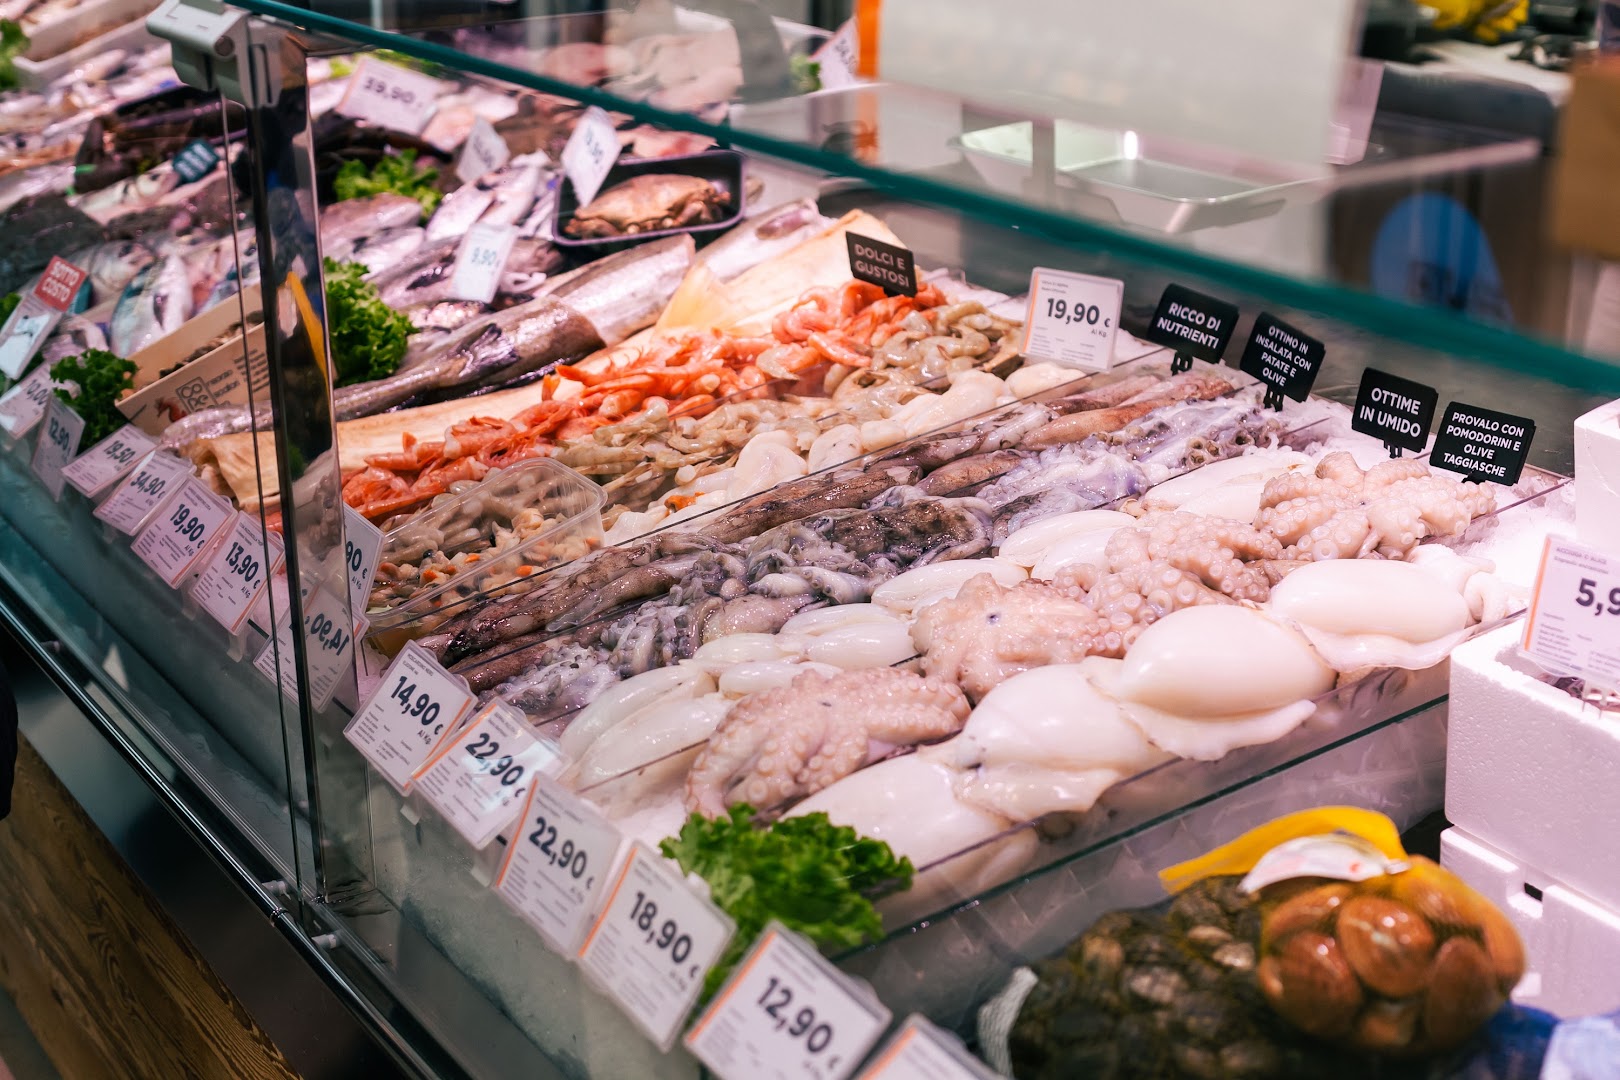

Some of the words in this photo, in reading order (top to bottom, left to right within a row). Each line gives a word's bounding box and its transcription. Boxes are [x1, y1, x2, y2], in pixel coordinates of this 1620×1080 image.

[854, 243, 894, 266] DOLCI
[896, 257, 906, 271] E
[50, 260, 80, 287] SOTTO
[855, 260, 910, 288] GUSTOSI
[41, 276, 71, 303] COSTO
[1047, 298, 1100, 326] 19,90
[1168, 302, 1206, 325] RICCO
[1206, 316, 1221, 332] DI
[1157, 316, 1220, 349] NUTRIENTI
[1268, 325, 1299, 349] OTTIMO
[1299, 341, 1309, 355] IN
[1255, 333, 1293, 361] INSALATA
[1293, 355, 1312, 371] CON
[1261, 351, 1290, 374] PATATE
[1289, 367, 1297, 378] E
[1262, 367, 1287, 387] OLIVE
[1371, 387, 1421, 415] OTTIME
[1360, 405, 1375, 422] IN
[1377, 411, 1421, 438] UMIDO
[1452, 411, 1499, 432] PROVALO
[1501, 424, 1525, 438] CON
[103, 440, 136, 463] 19,50
[1446, 424, 1513, 449] POMODORINI
[1513, 441, 1522, 451] E
[1463, 443, 1495, 460] OLIVE
[1443, 452, 1507, 477] TAGGIASCHE
[130, 471, 166, 496] 34,90
[170, 503, 206, 542] 19,90
[225, 541, 259, 582] 13,90
[347, 540, 363, 572] 90
[362, 567, 369, 580] €
[391, 676, 440, 726] 14,90
[465, 732, 524, 786] 22,90
[528, 816, 587, 879] 22,90
[630, 891, 692, 964] 18,90
[758, 977, 833, 1053] 12,90
